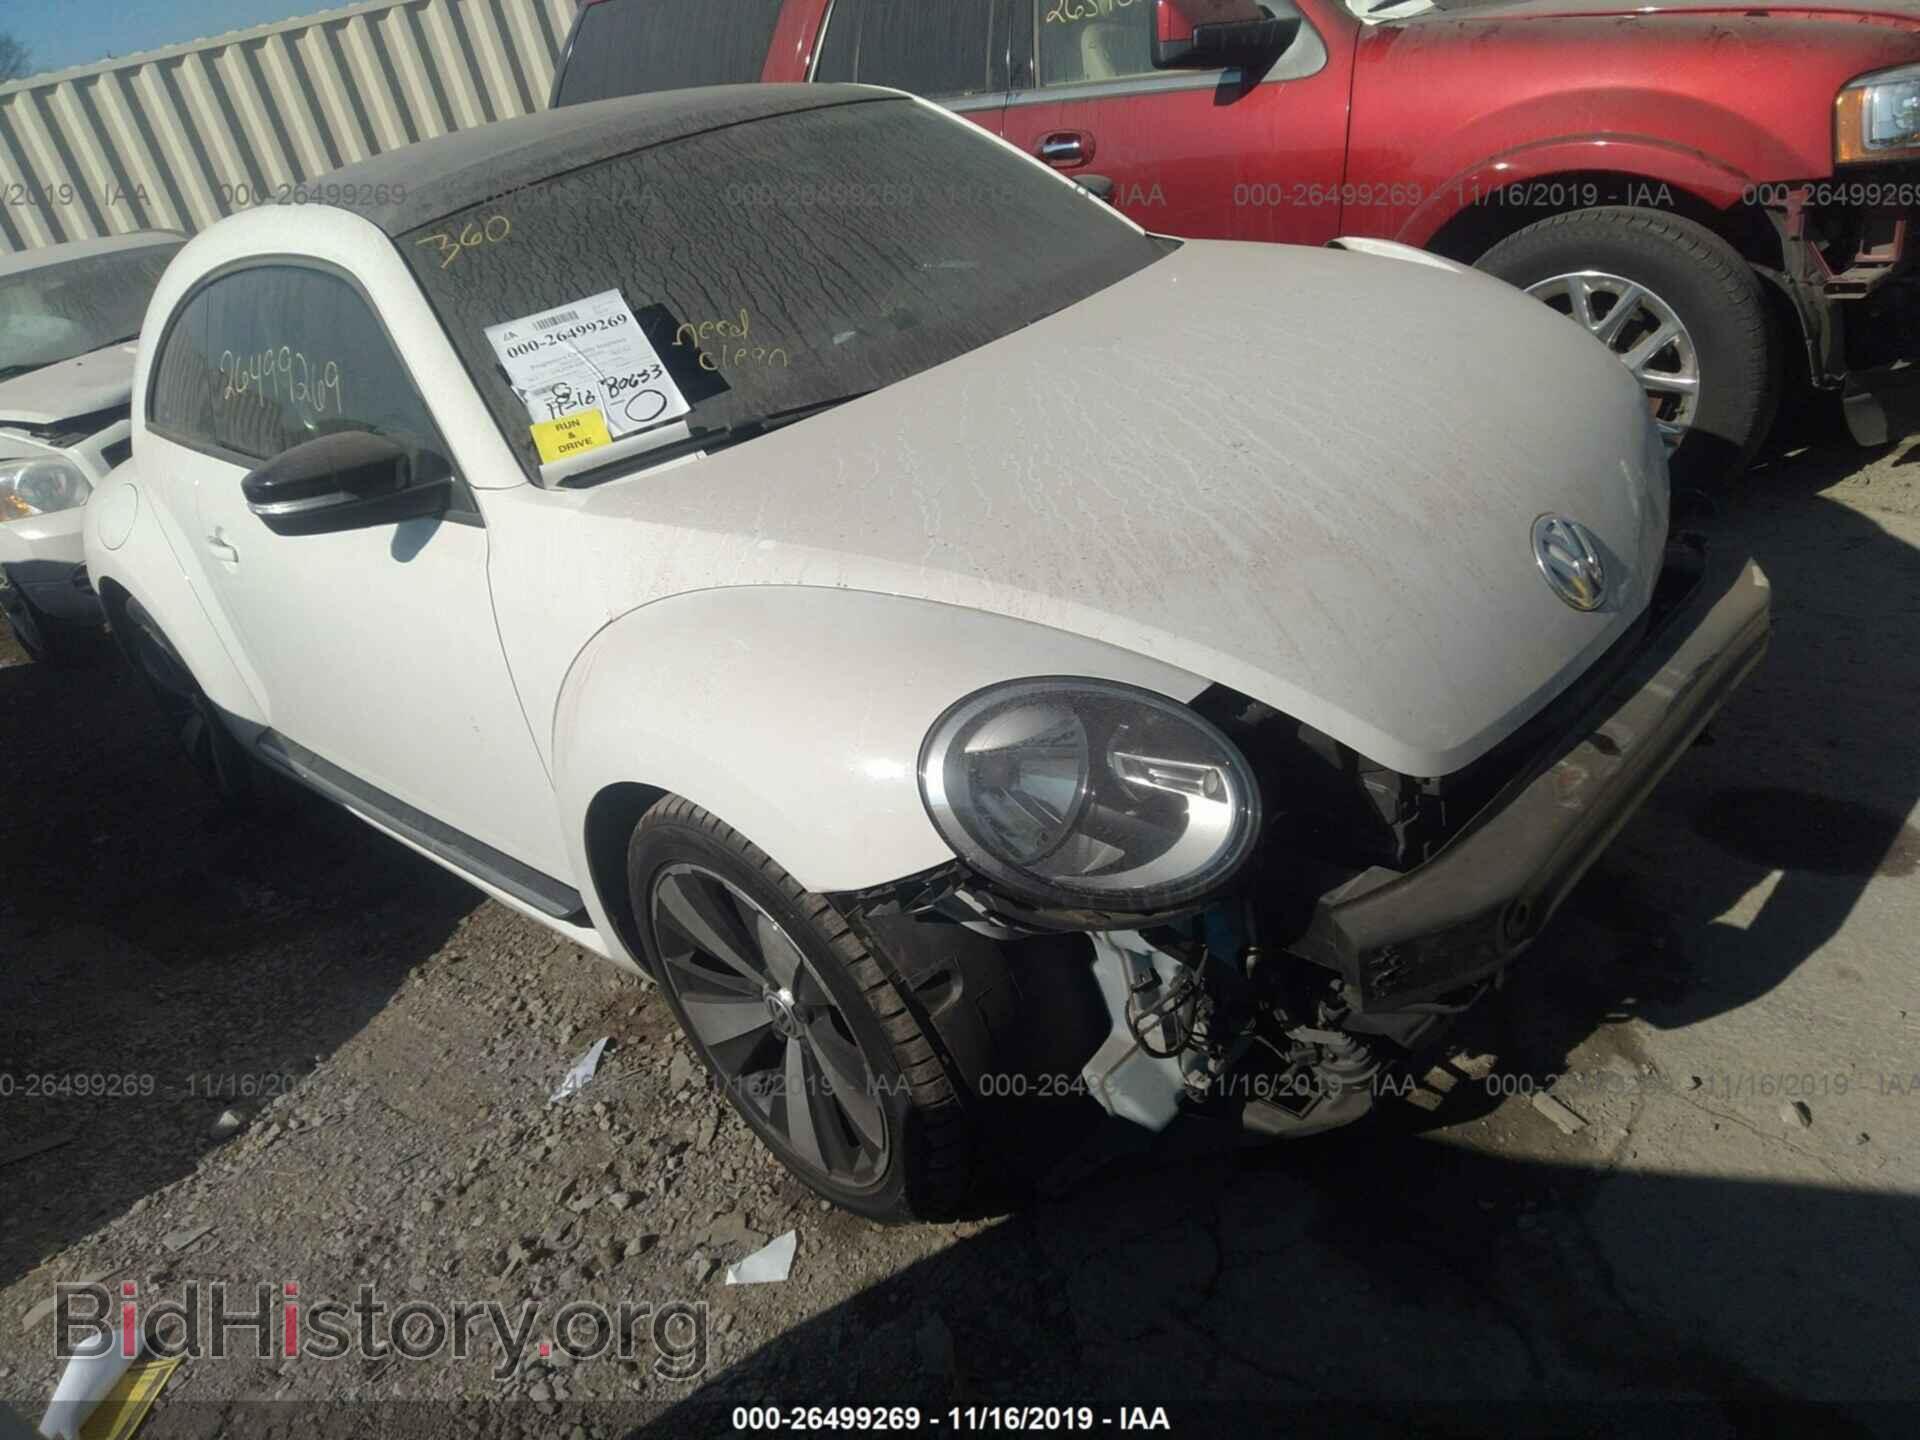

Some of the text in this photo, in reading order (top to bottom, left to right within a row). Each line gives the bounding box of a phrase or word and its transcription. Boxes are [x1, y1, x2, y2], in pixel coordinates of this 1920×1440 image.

[415, 215, 510, 270] 360
[506, 312, 628, 359] 000-26499269
[671, 307, 749, 348] need
[219, 345, 342, 415] 26499269
[554, 419, 581, 431] RUN
[557, 437, 593, 453] DRIVE
